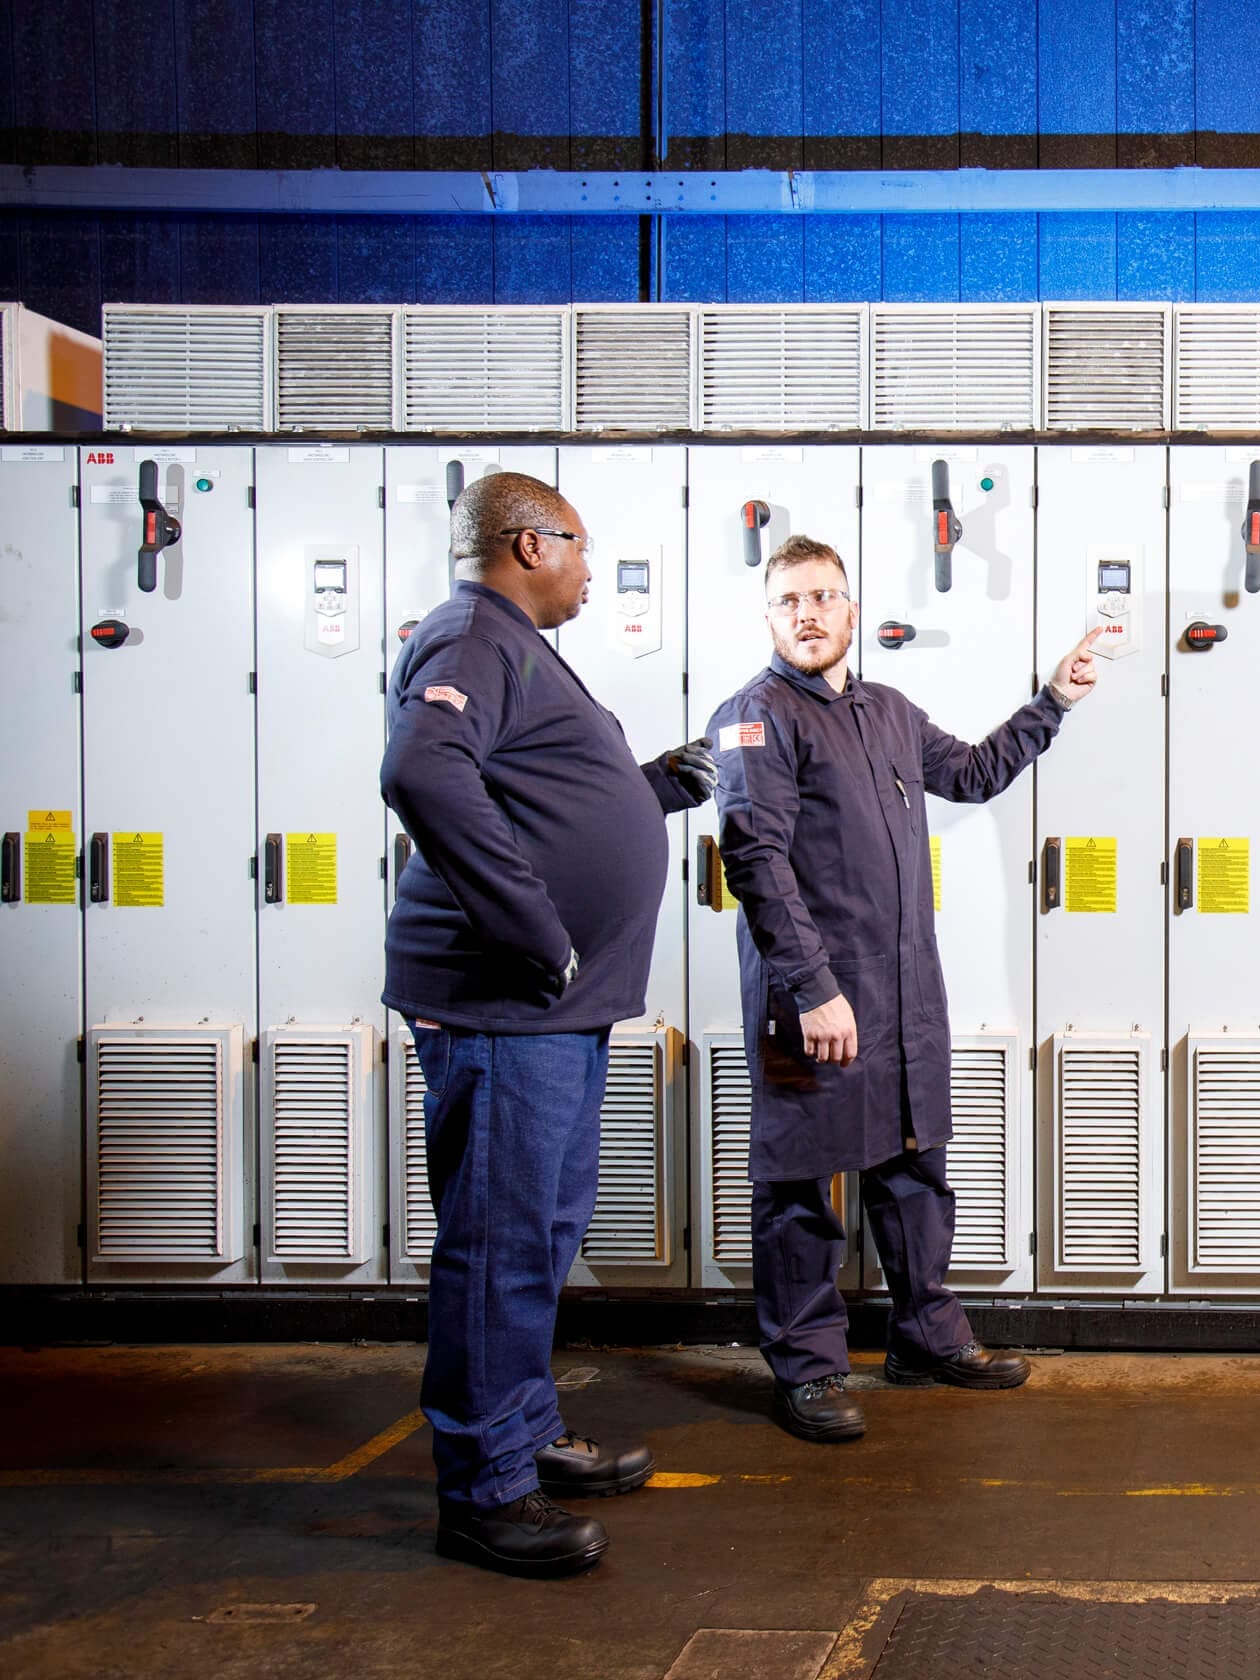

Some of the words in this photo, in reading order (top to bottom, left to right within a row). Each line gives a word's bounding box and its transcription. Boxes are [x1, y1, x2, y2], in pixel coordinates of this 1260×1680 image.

[87, 452, 115, 465] ABB
[322, 624, 342, 633] ABB
[624, 624, 643, 633] ABB
[1104, 625, 1124, 634] ABB
